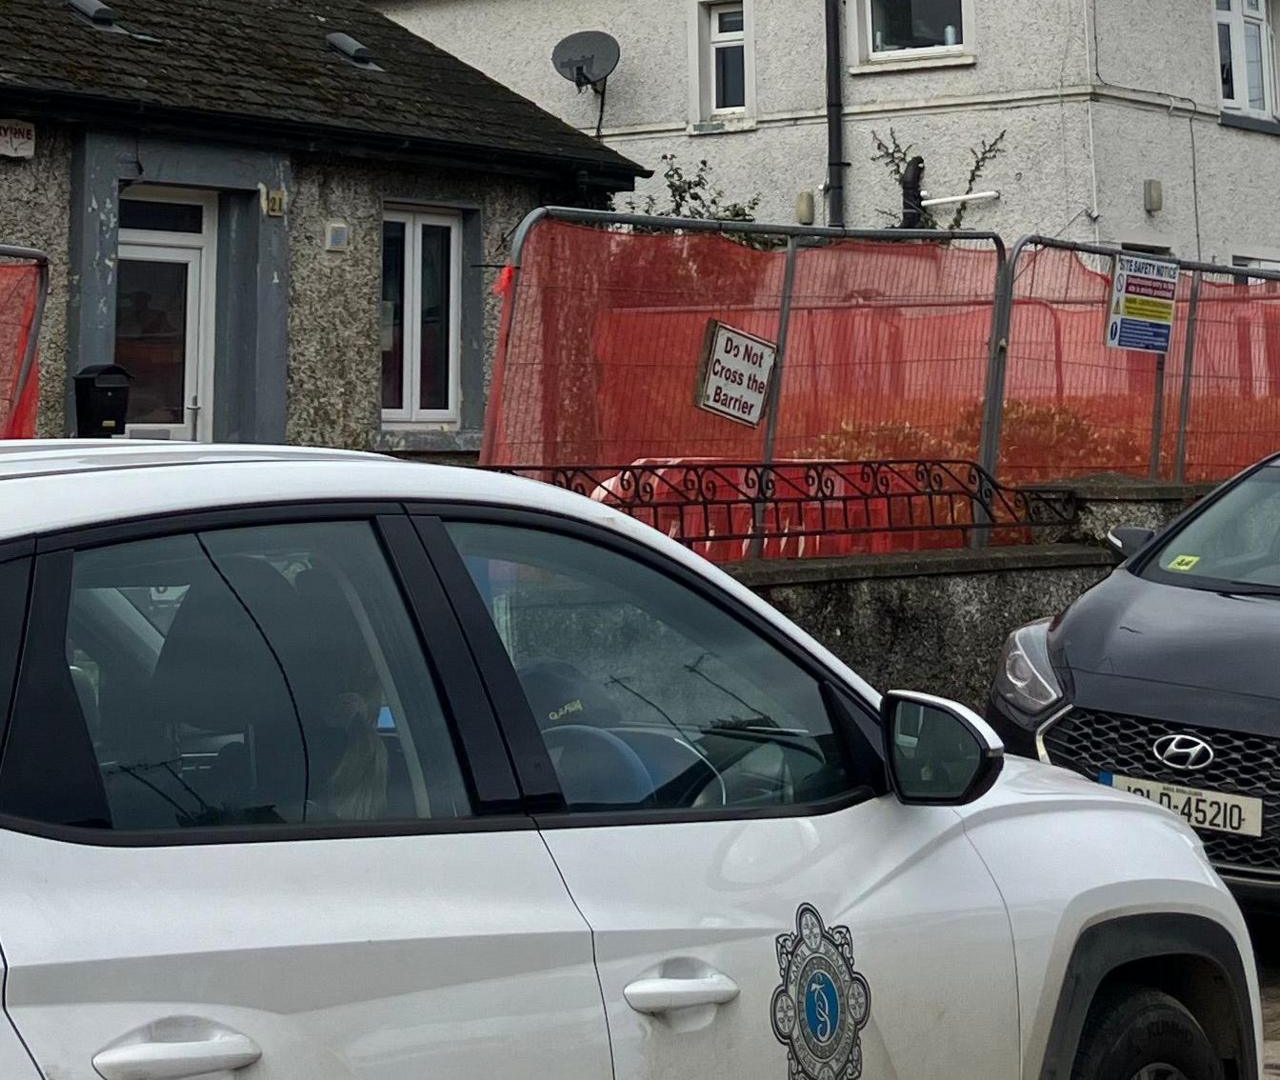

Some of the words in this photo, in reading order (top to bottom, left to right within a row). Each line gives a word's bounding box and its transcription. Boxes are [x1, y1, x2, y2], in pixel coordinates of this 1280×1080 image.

[1120, 259, 1134, 272] SITE
[1134, 261, 1156, 275] SAFETY
[1156, 264, 1178, 279] NOTICE
[724, 337, 739, 358] Do
[743, 344, 764, 368] Not
[712, 358, 744, 386] Cross
[747, 373, 765, 394] the
[713, 386, 755, 416] Barrier
